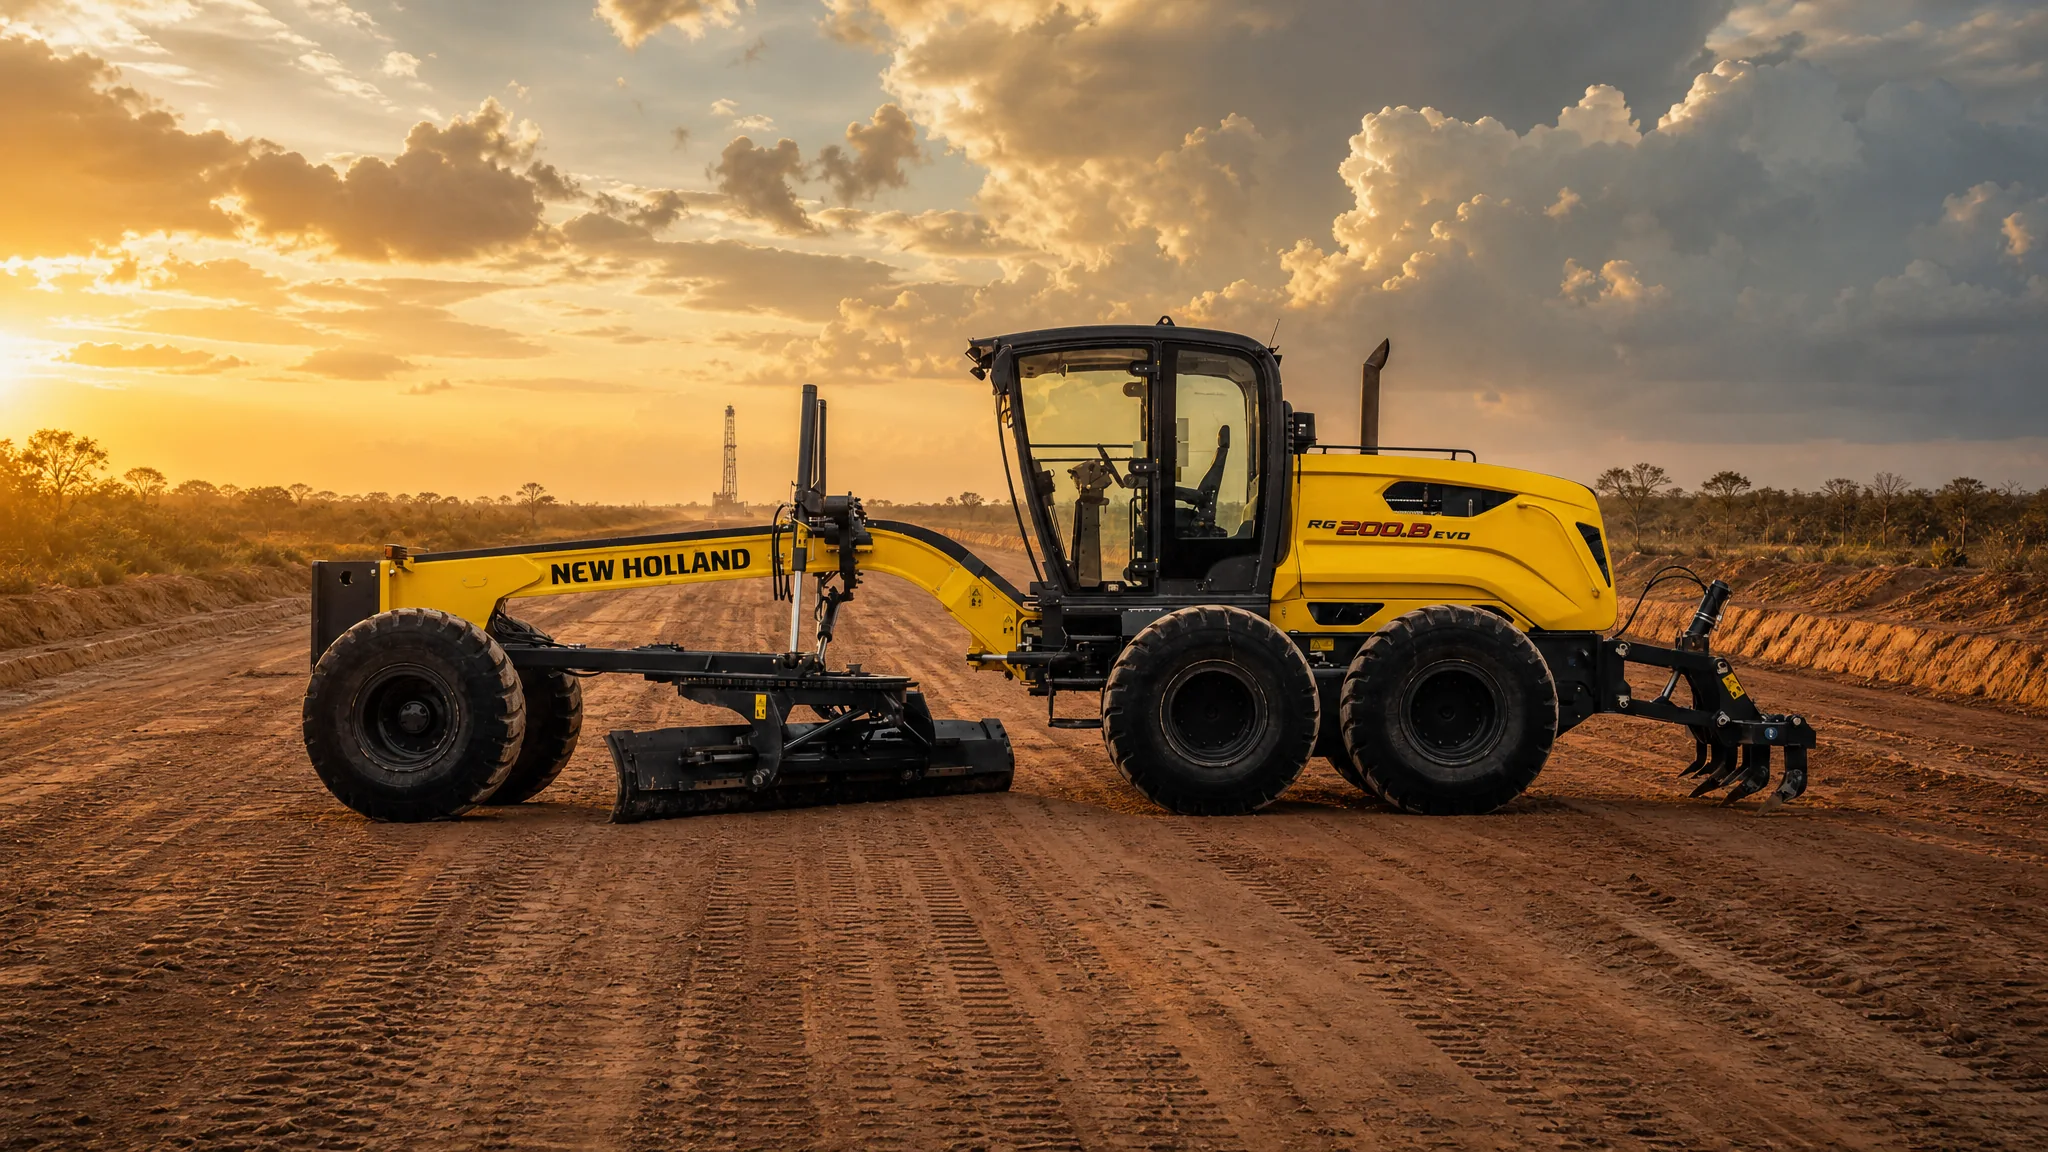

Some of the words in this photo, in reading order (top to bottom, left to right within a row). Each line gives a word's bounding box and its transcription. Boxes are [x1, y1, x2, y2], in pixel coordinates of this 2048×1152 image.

[1307, 520, 1337, 529] RG
[1336, 521, 1432, 538] 200.B
[1433, 531, 1471, 540] EVO
[551, 559, 614, 584] NEW
[622, 548, 751, 578] HOLLAND
